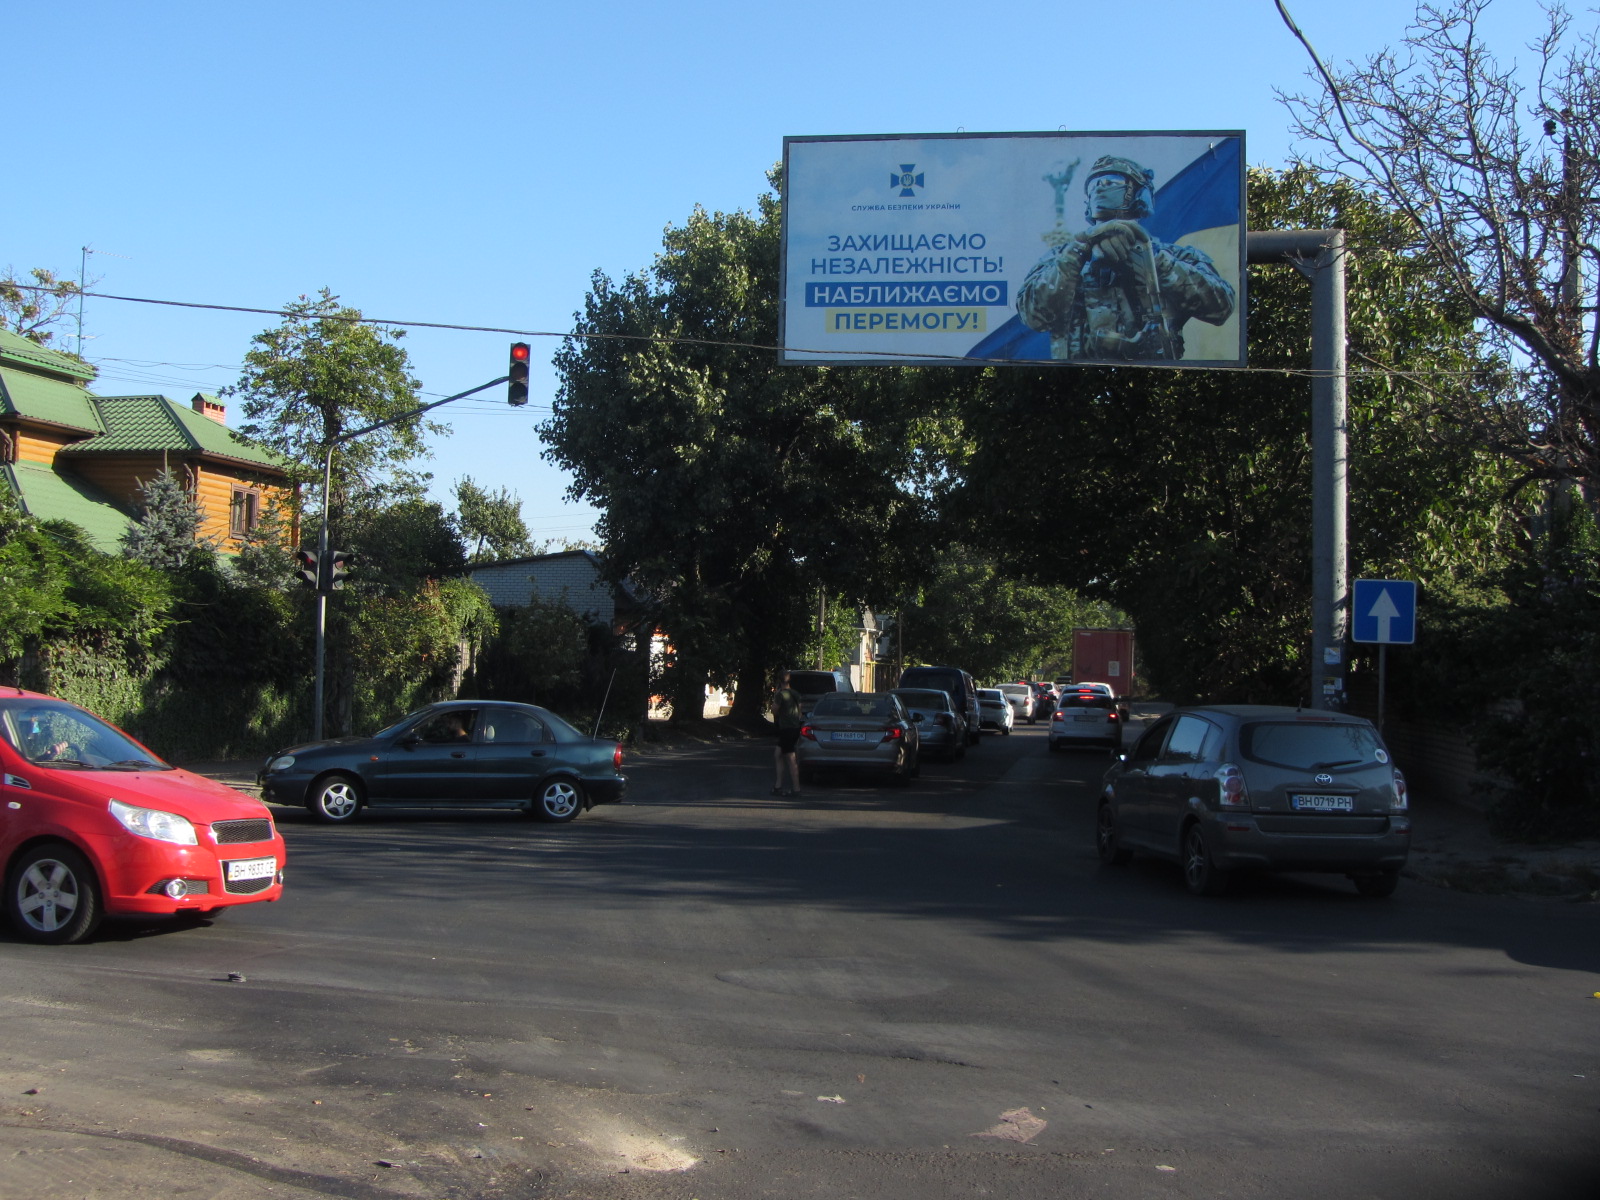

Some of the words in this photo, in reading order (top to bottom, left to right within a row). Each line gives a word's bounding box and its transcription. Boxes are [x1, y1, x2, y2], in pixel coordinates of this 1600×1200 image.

[828, 234, 986, 253] ЗАХИЩАЄМО
[811, 256, 1003, 275] НЕЗАЛЕЖНІСТЬ!
[814, 285, 1001, 304] НАБЛИЖАЄМО
[835, 312, 978, 330] ПЕРЕМОГУ!
[1298, 796, 1312, 806] BH
[1314, 796, 1335, 807] 0719
